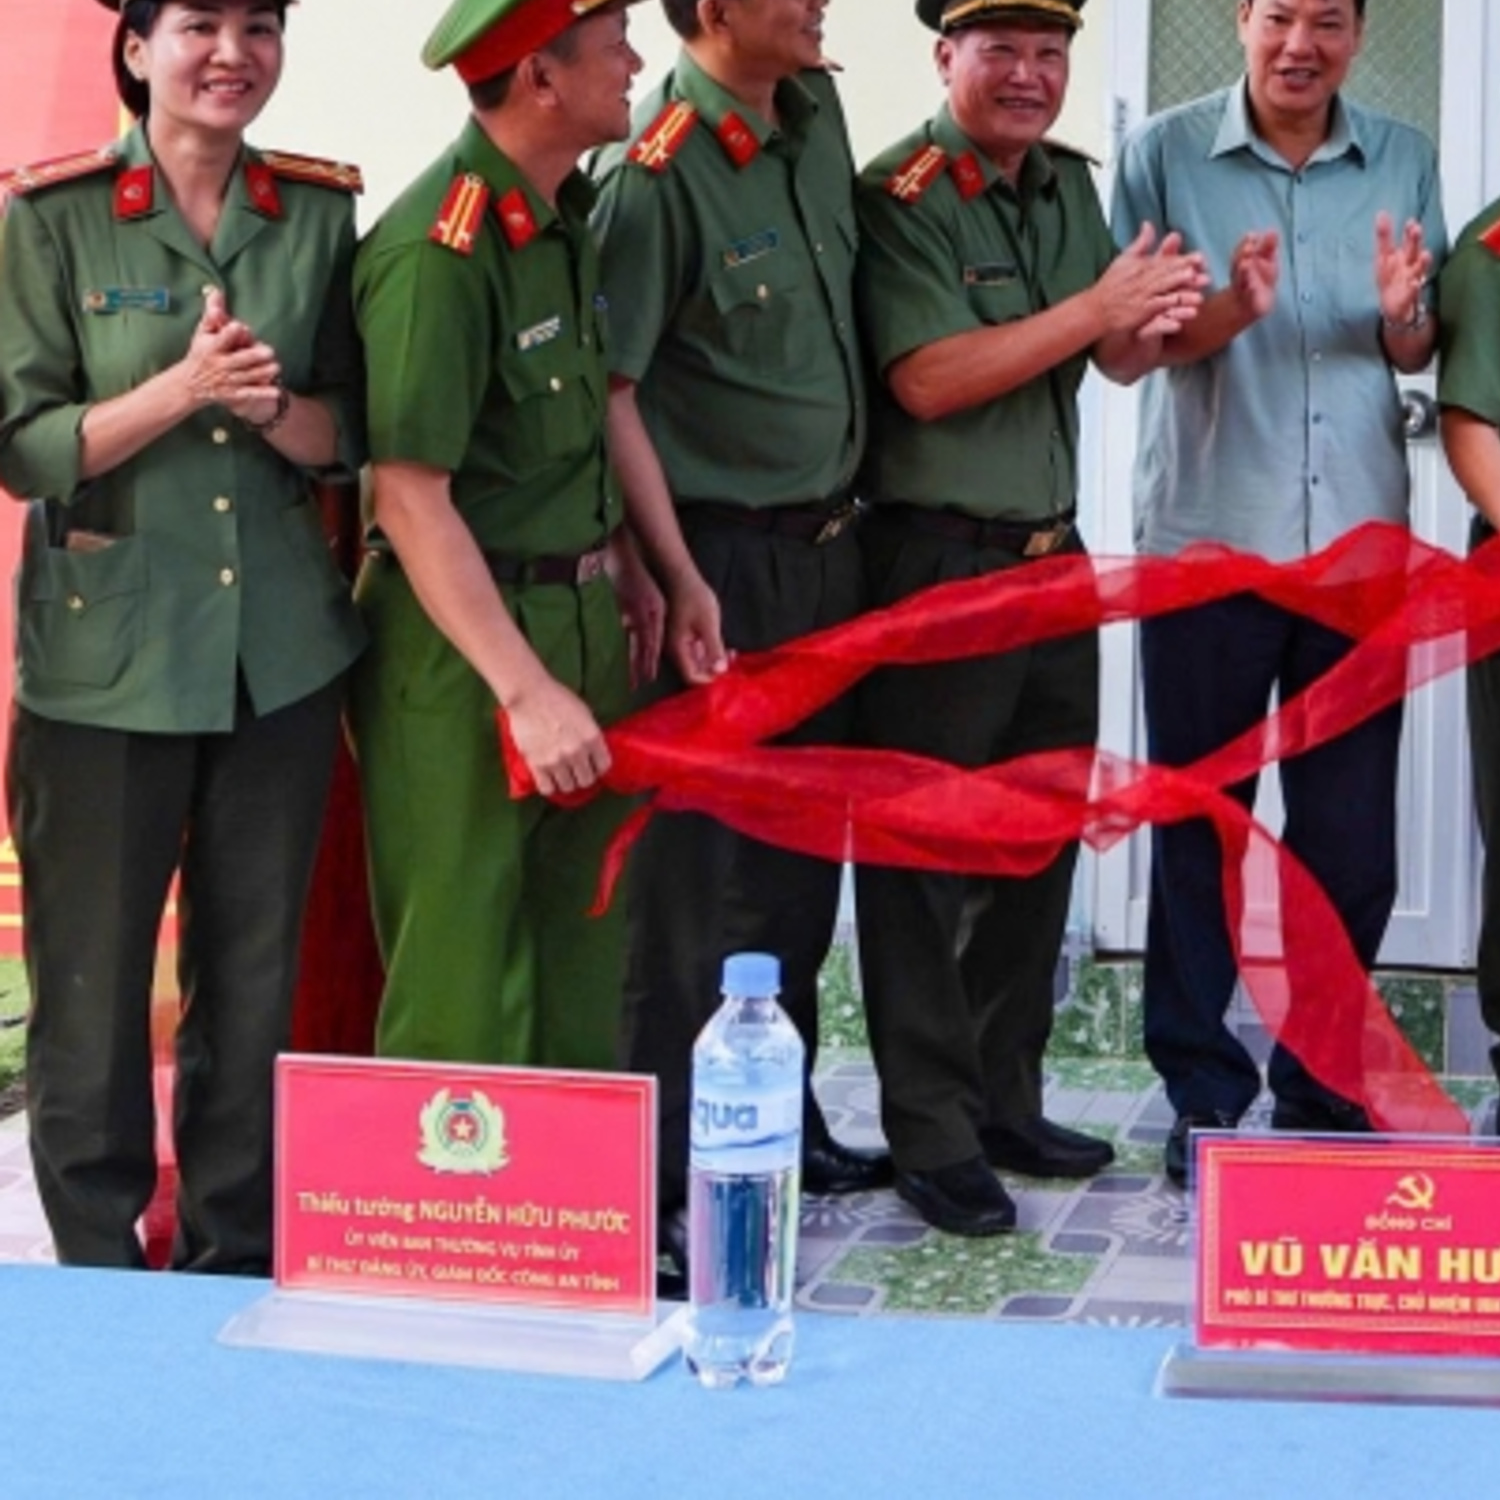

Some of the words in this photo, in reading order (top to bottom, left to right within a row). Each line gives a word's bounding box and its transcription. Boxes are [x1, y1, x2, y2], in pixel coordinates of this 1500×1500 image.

[297, 1191, 350, 1217] Thiếu
[354, 1196, 416, 1224] tướng
[418, 1195, 499, 1225] NGUYỄN
[505, 1200, 552, 1228] HỮU
[558, 1207, 631, 1235] PHƯỚC
[1238, 1235, 1304, 1278] VŨ
[1318, 1236, 1422, 1281] VĂN
